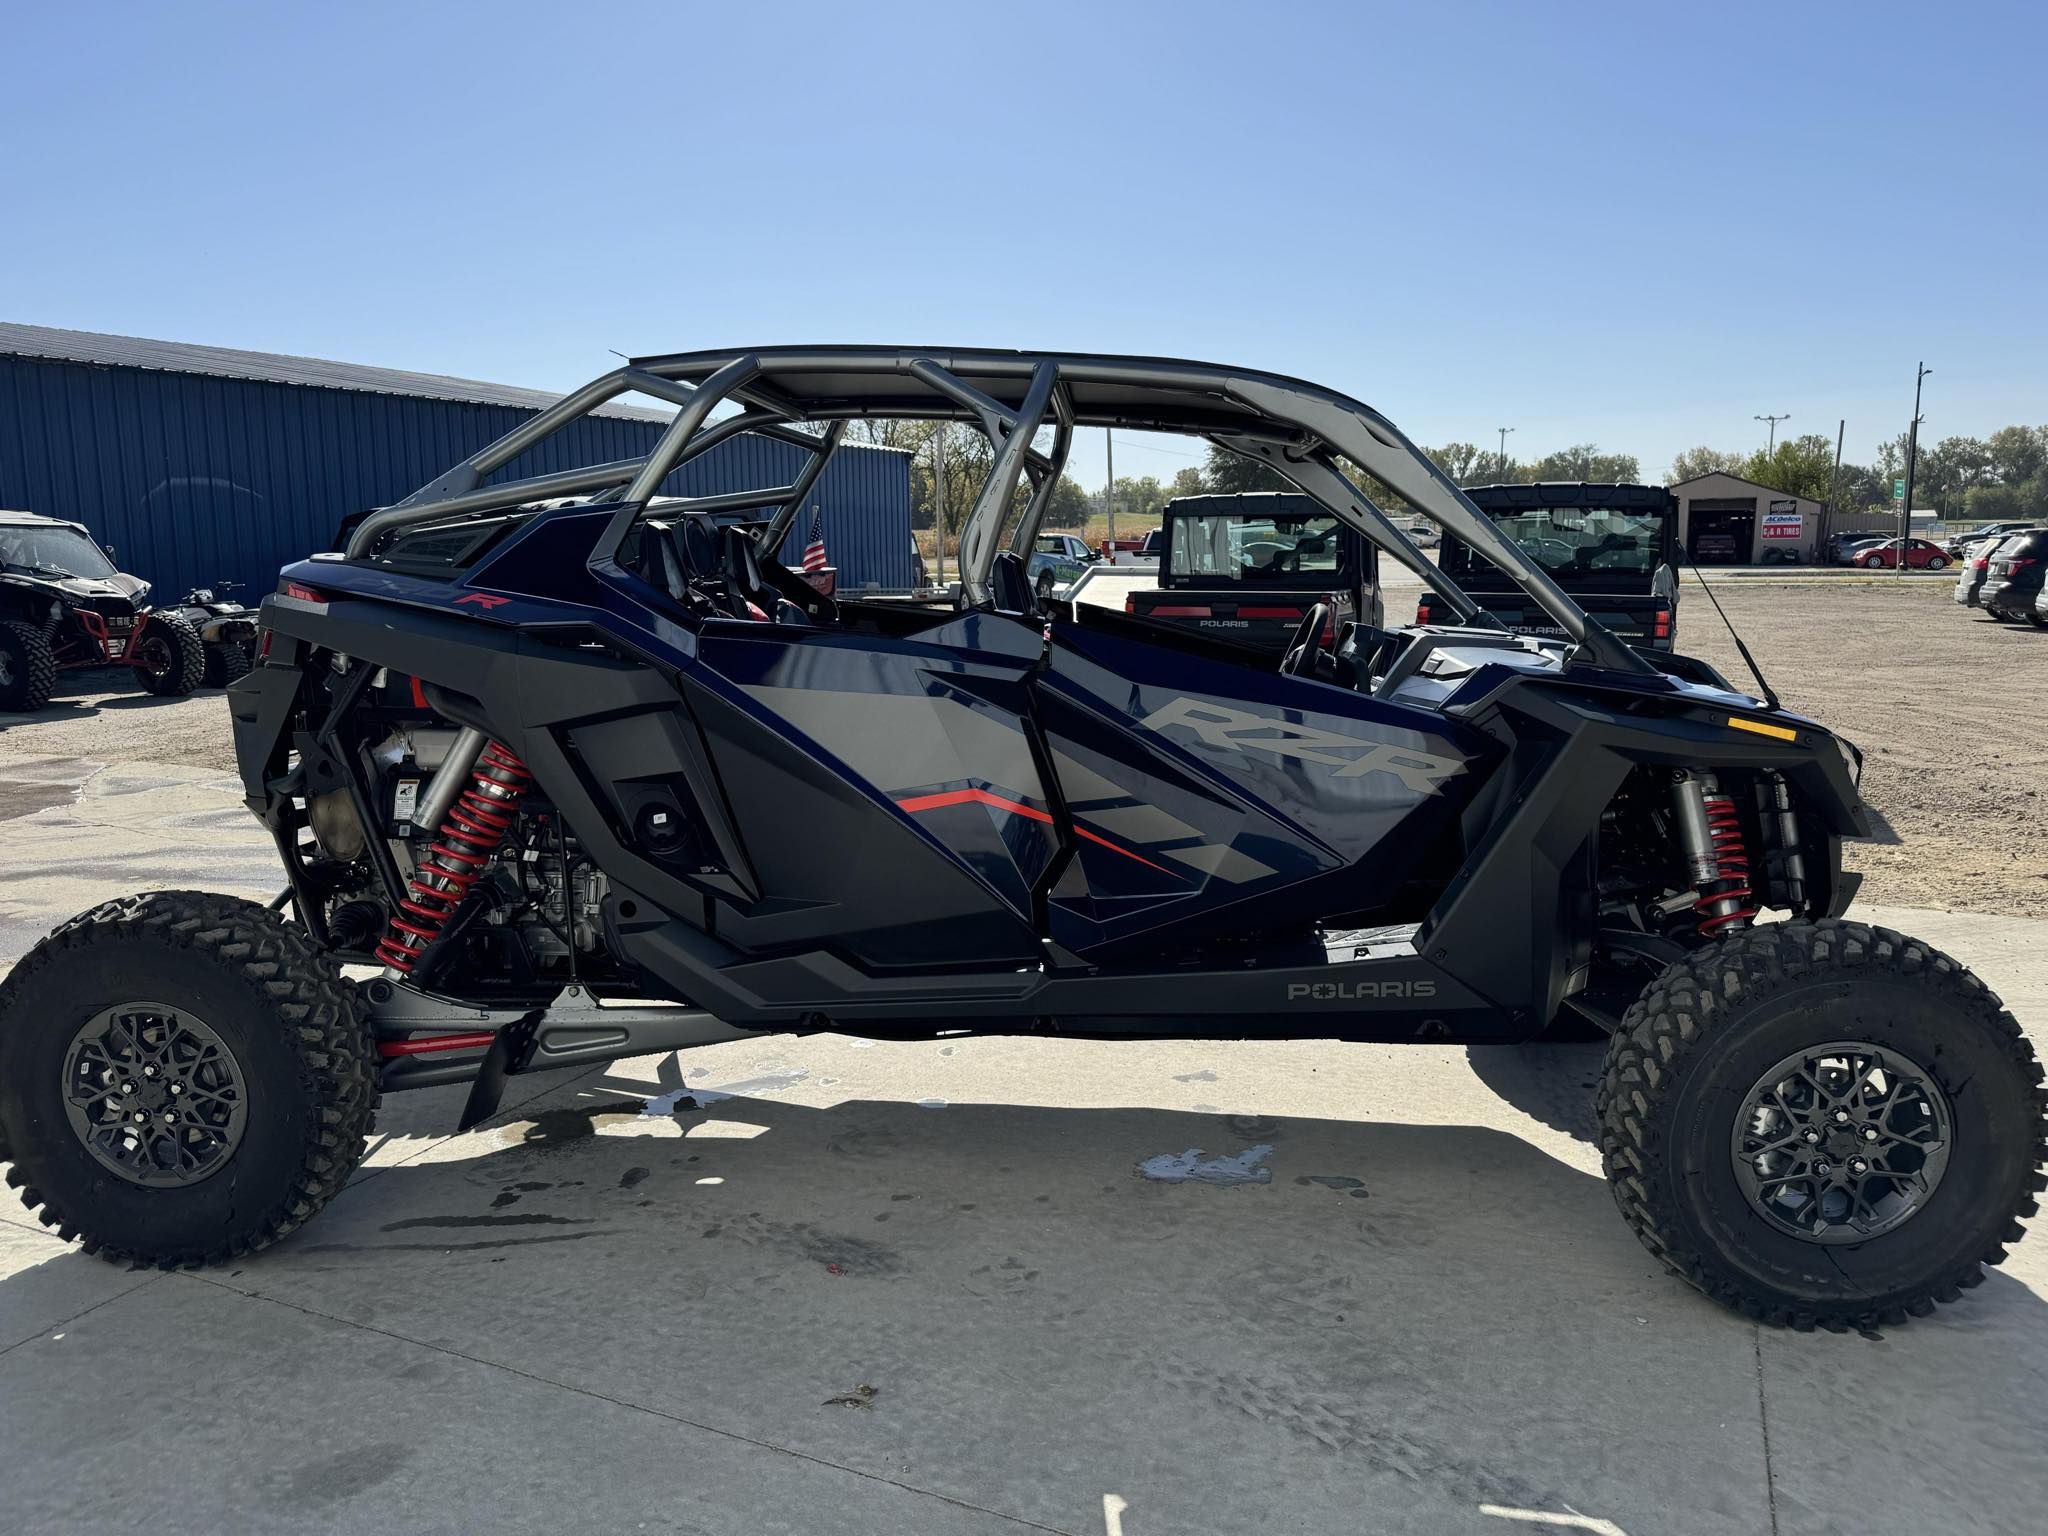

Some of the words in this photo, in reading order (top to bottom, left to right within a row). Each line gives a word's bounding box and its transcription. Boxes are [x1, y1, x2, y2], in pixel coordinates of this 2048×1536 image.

[1783, 527, 1800, 535] TIRES
[1200, 620, 1249, 628] POLARIS
[1509, 625, 1568, 635] POLARIS
[1131, 697, 1470, 797] RZR
[1287, 980, 1437, 1001] POLARIS
